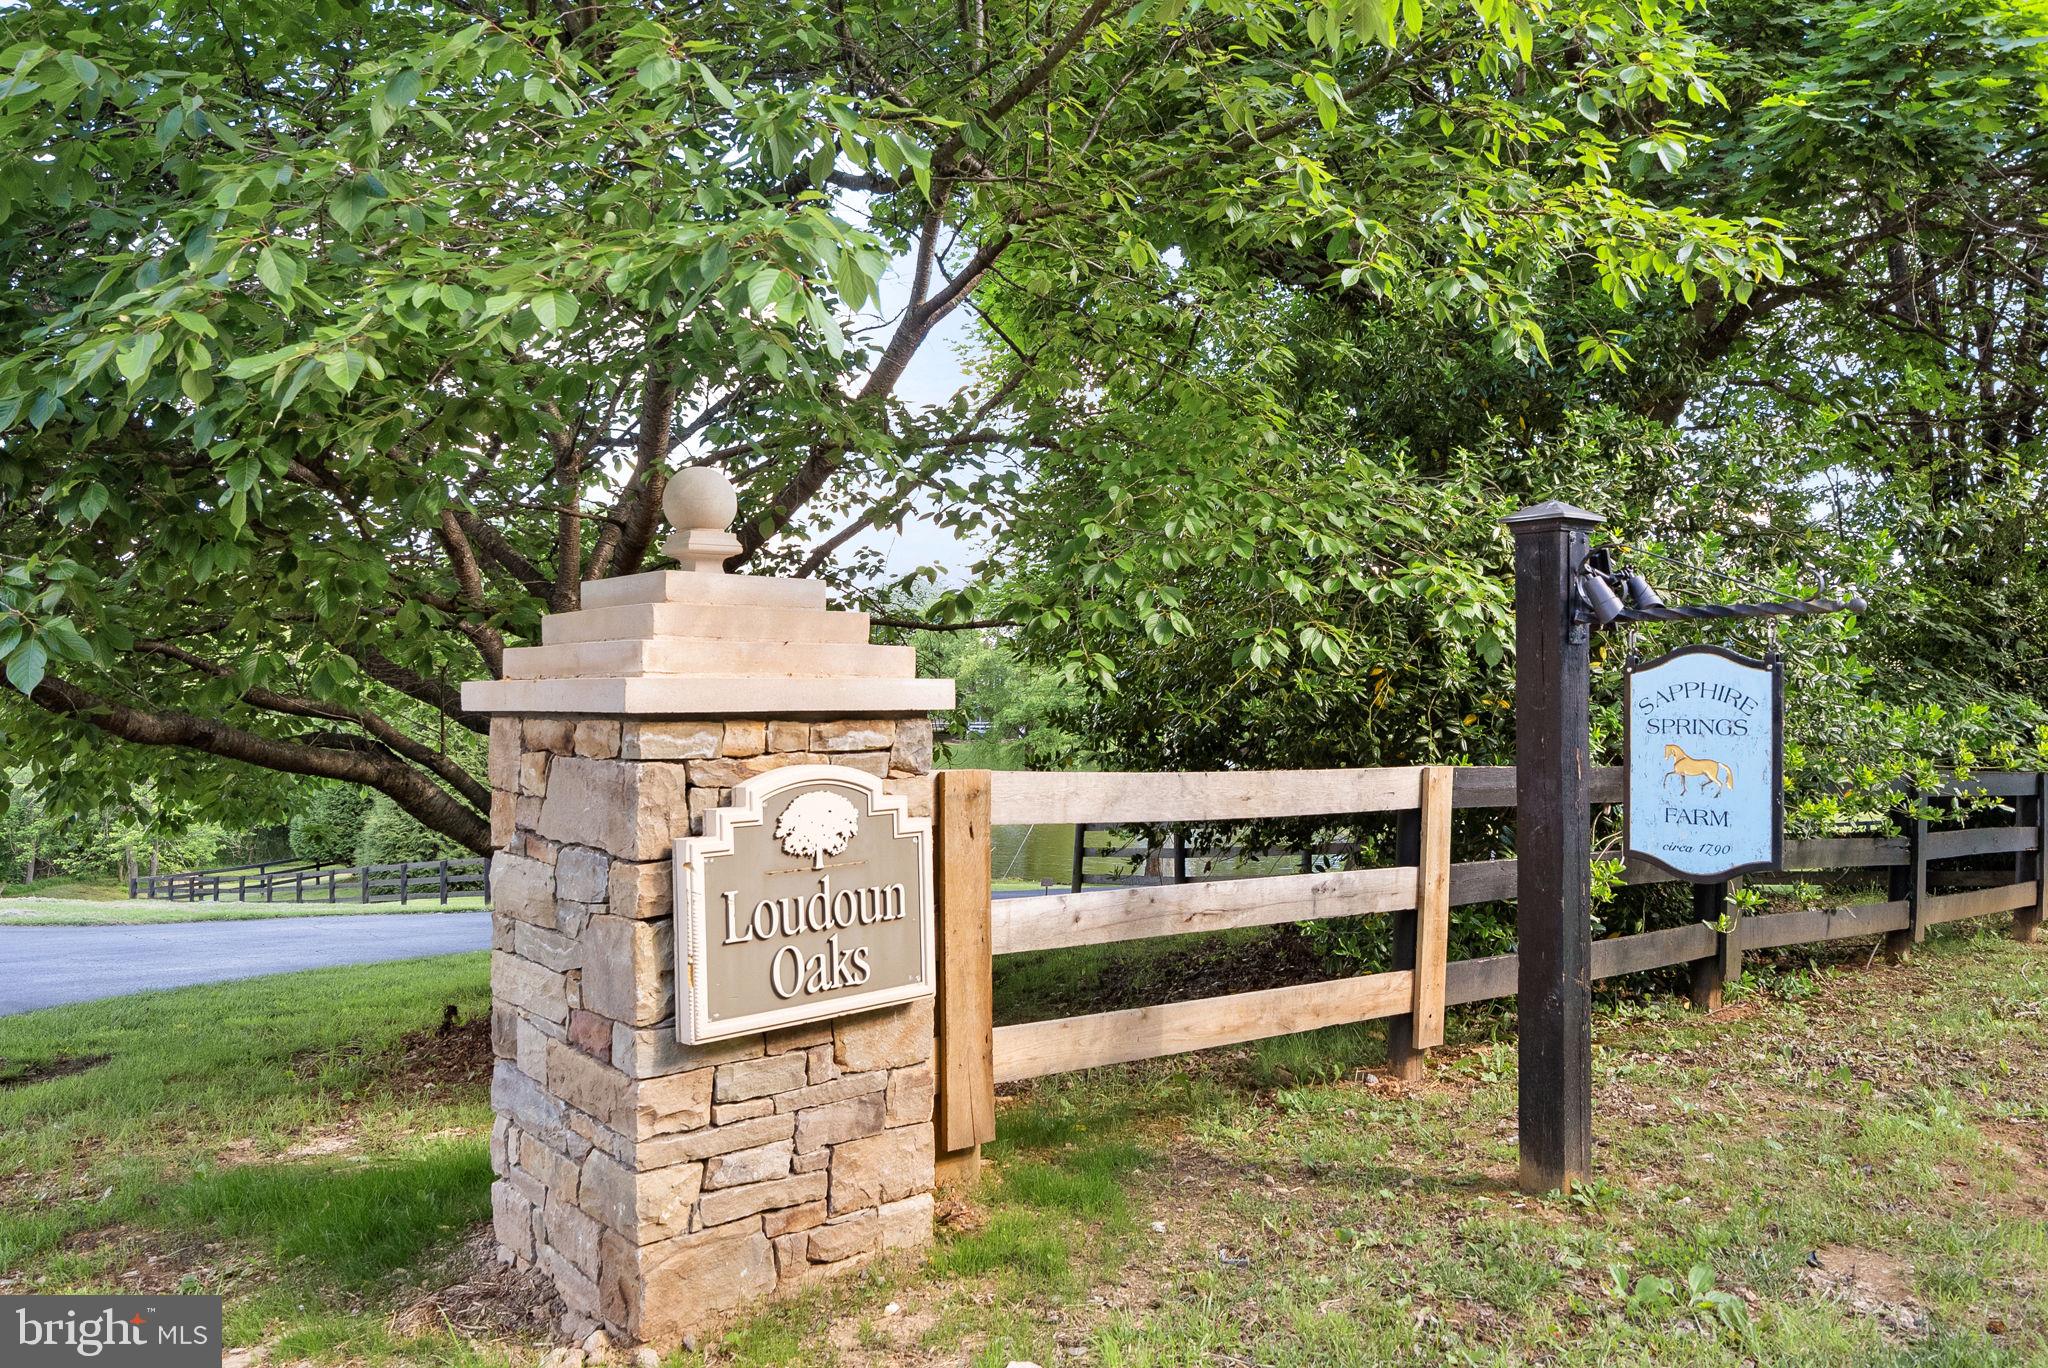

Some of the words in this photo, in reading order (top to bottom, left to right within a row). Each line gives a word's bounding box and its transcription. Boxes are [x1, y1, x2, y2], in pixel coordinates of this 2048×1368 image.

[1638, 681, 1759, 717] SAPPHIRE
[1646, 718, 1748, 737] SPRINGS
[1664, 807, 1729, 827] FARM
[1662, 841, 1694, 854] circa
[1699, 843, 1731, 857] 1790
[721, 874, 907, 945] Loudoun
[771, 933, 871, 999] Oaks
